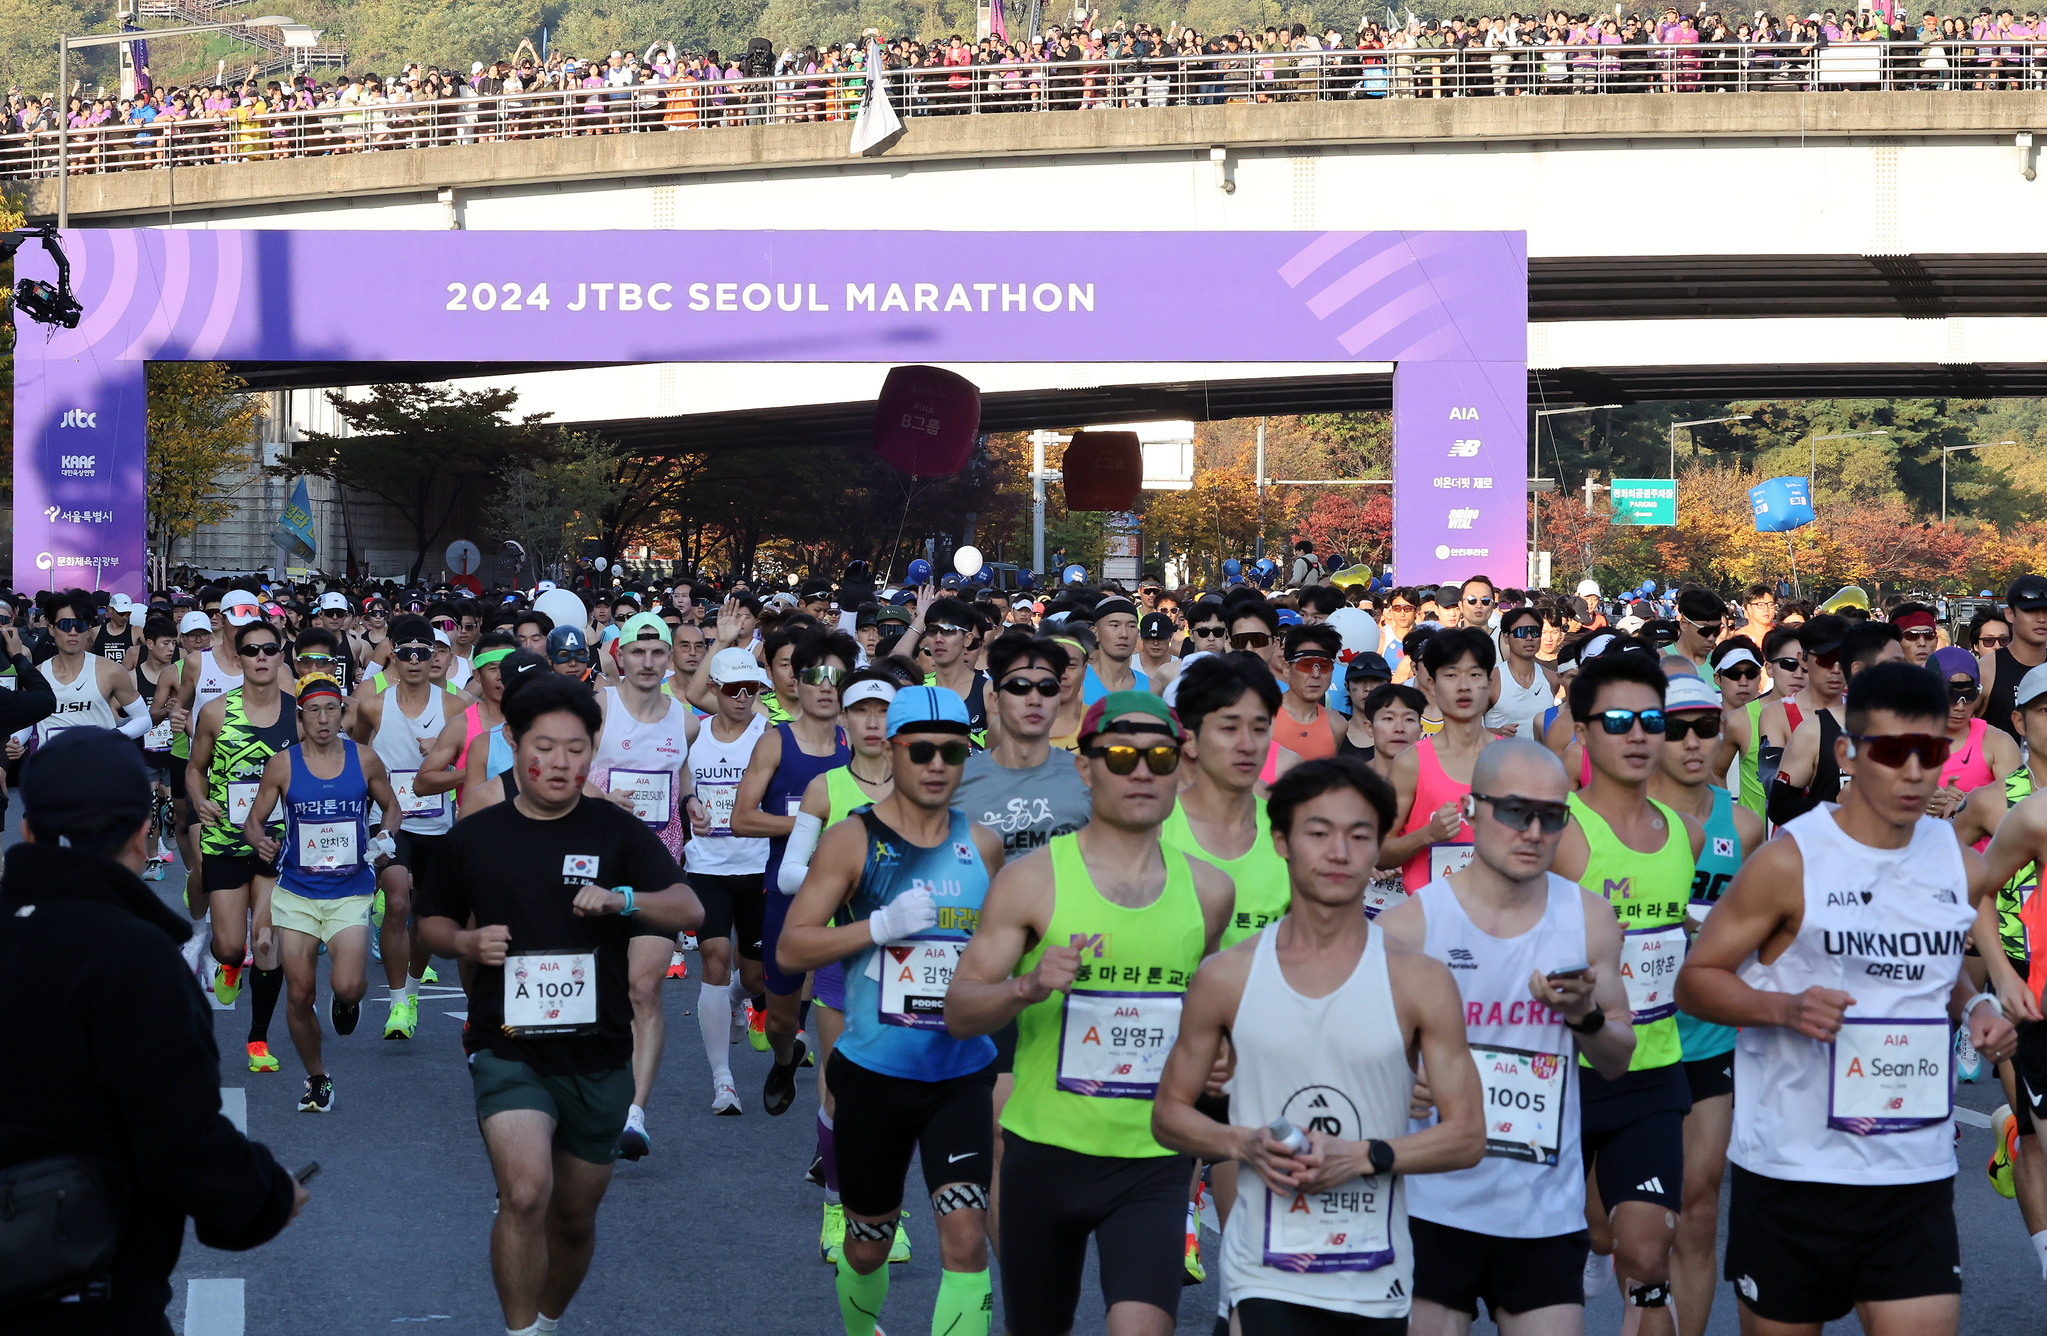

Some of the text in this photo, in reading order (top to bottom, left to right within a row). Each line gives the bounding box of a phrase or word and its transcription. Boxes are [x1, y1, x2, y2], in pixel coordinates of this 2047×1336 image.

[445, 282, 1095, 312] 2024 JTBC SEOUL MARATHON
[60, 408, 97, 429] jtbc
[1449, 406, 1480, 421] AIA
[901, 413, 941, 436] B그룹
[61, 455, 96, 469] KAAF
[1433, 476, 1493, 489] 이온더핏 제로
[1613, 488, 1674, 499] 평화의공원주차장
[61, 510, 113, 523] 서울특별시
[1448, 506, 1480, 520] amino
[1448, 518, 1473, 530] VITAL
[56, 556, 120, 567] 문화체육관광부
[566, 632, 579, 646] A
[107, 651, 123, 660] NB
[398, 786, 407, 795] A
[237, 798, 246, 807] A
[705, 800, 712, 809] A
[307, 836, 349, 849] A 안치정
[1442, 865, 1454, 877] A
[1827, 891, 1859, 907] AIA
[1641, 941, 1661, 952] AIA
[1824, 930, 1967, 957] UNKNOWN
[924, 948, 946, 958] AIA
[539, 962, 560, 972] AIA
[898, 965, 914, 983] A
[1620, 954, 1676, 980] A 이창훈
[1866, 962, 1926, 981] CREW
[515, 981, 585, 999] A 1007
[1114, 1006, 1140, 1018] AIA
[1082, 1026, 1165, 1048] A 임영규
[1884, 1034, 1909, 1047] AIA
[1493, 1061, 1518, 1075] AIA
[1846, 1057, 1939, 1078] A Sean Ro
[1487, 1086, 1546, 1113] 1005
[1289, 1192, 1311, 1215] A
